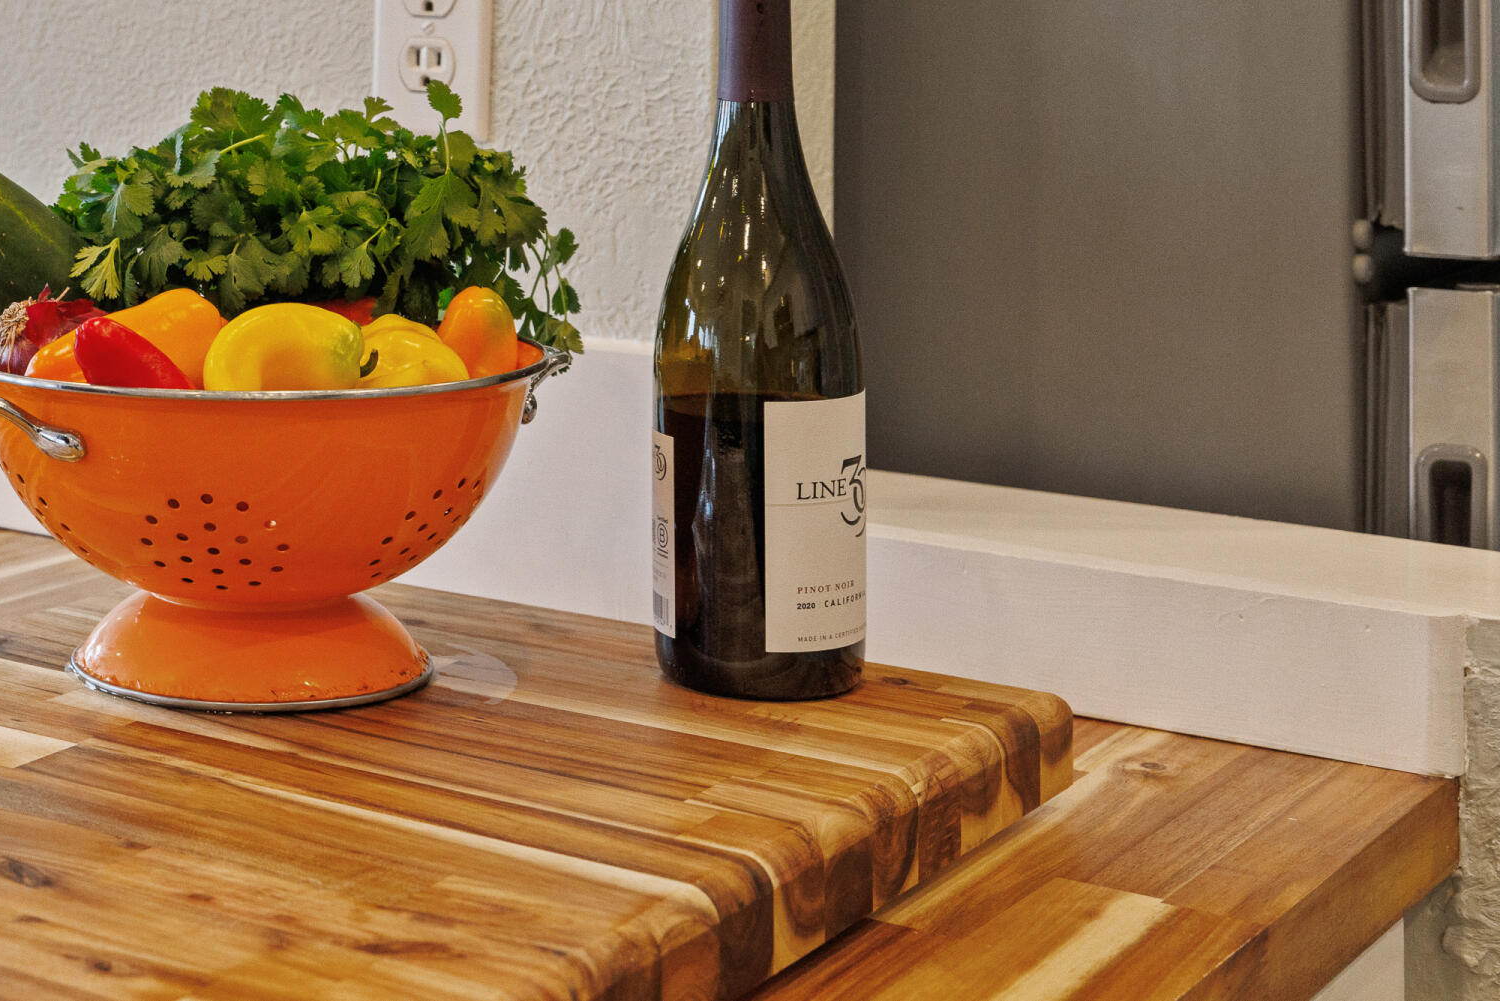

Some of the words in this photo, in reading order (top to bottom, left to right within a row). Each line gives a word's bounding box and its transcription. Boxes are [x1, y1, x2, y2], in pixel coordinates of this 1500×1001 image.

[796, 478, 847, 500] LINE
[797, 584, 832, 595] PINOT
[835, 580, 855, 592] NOIR
[797, 602, 816, 610] 2020
